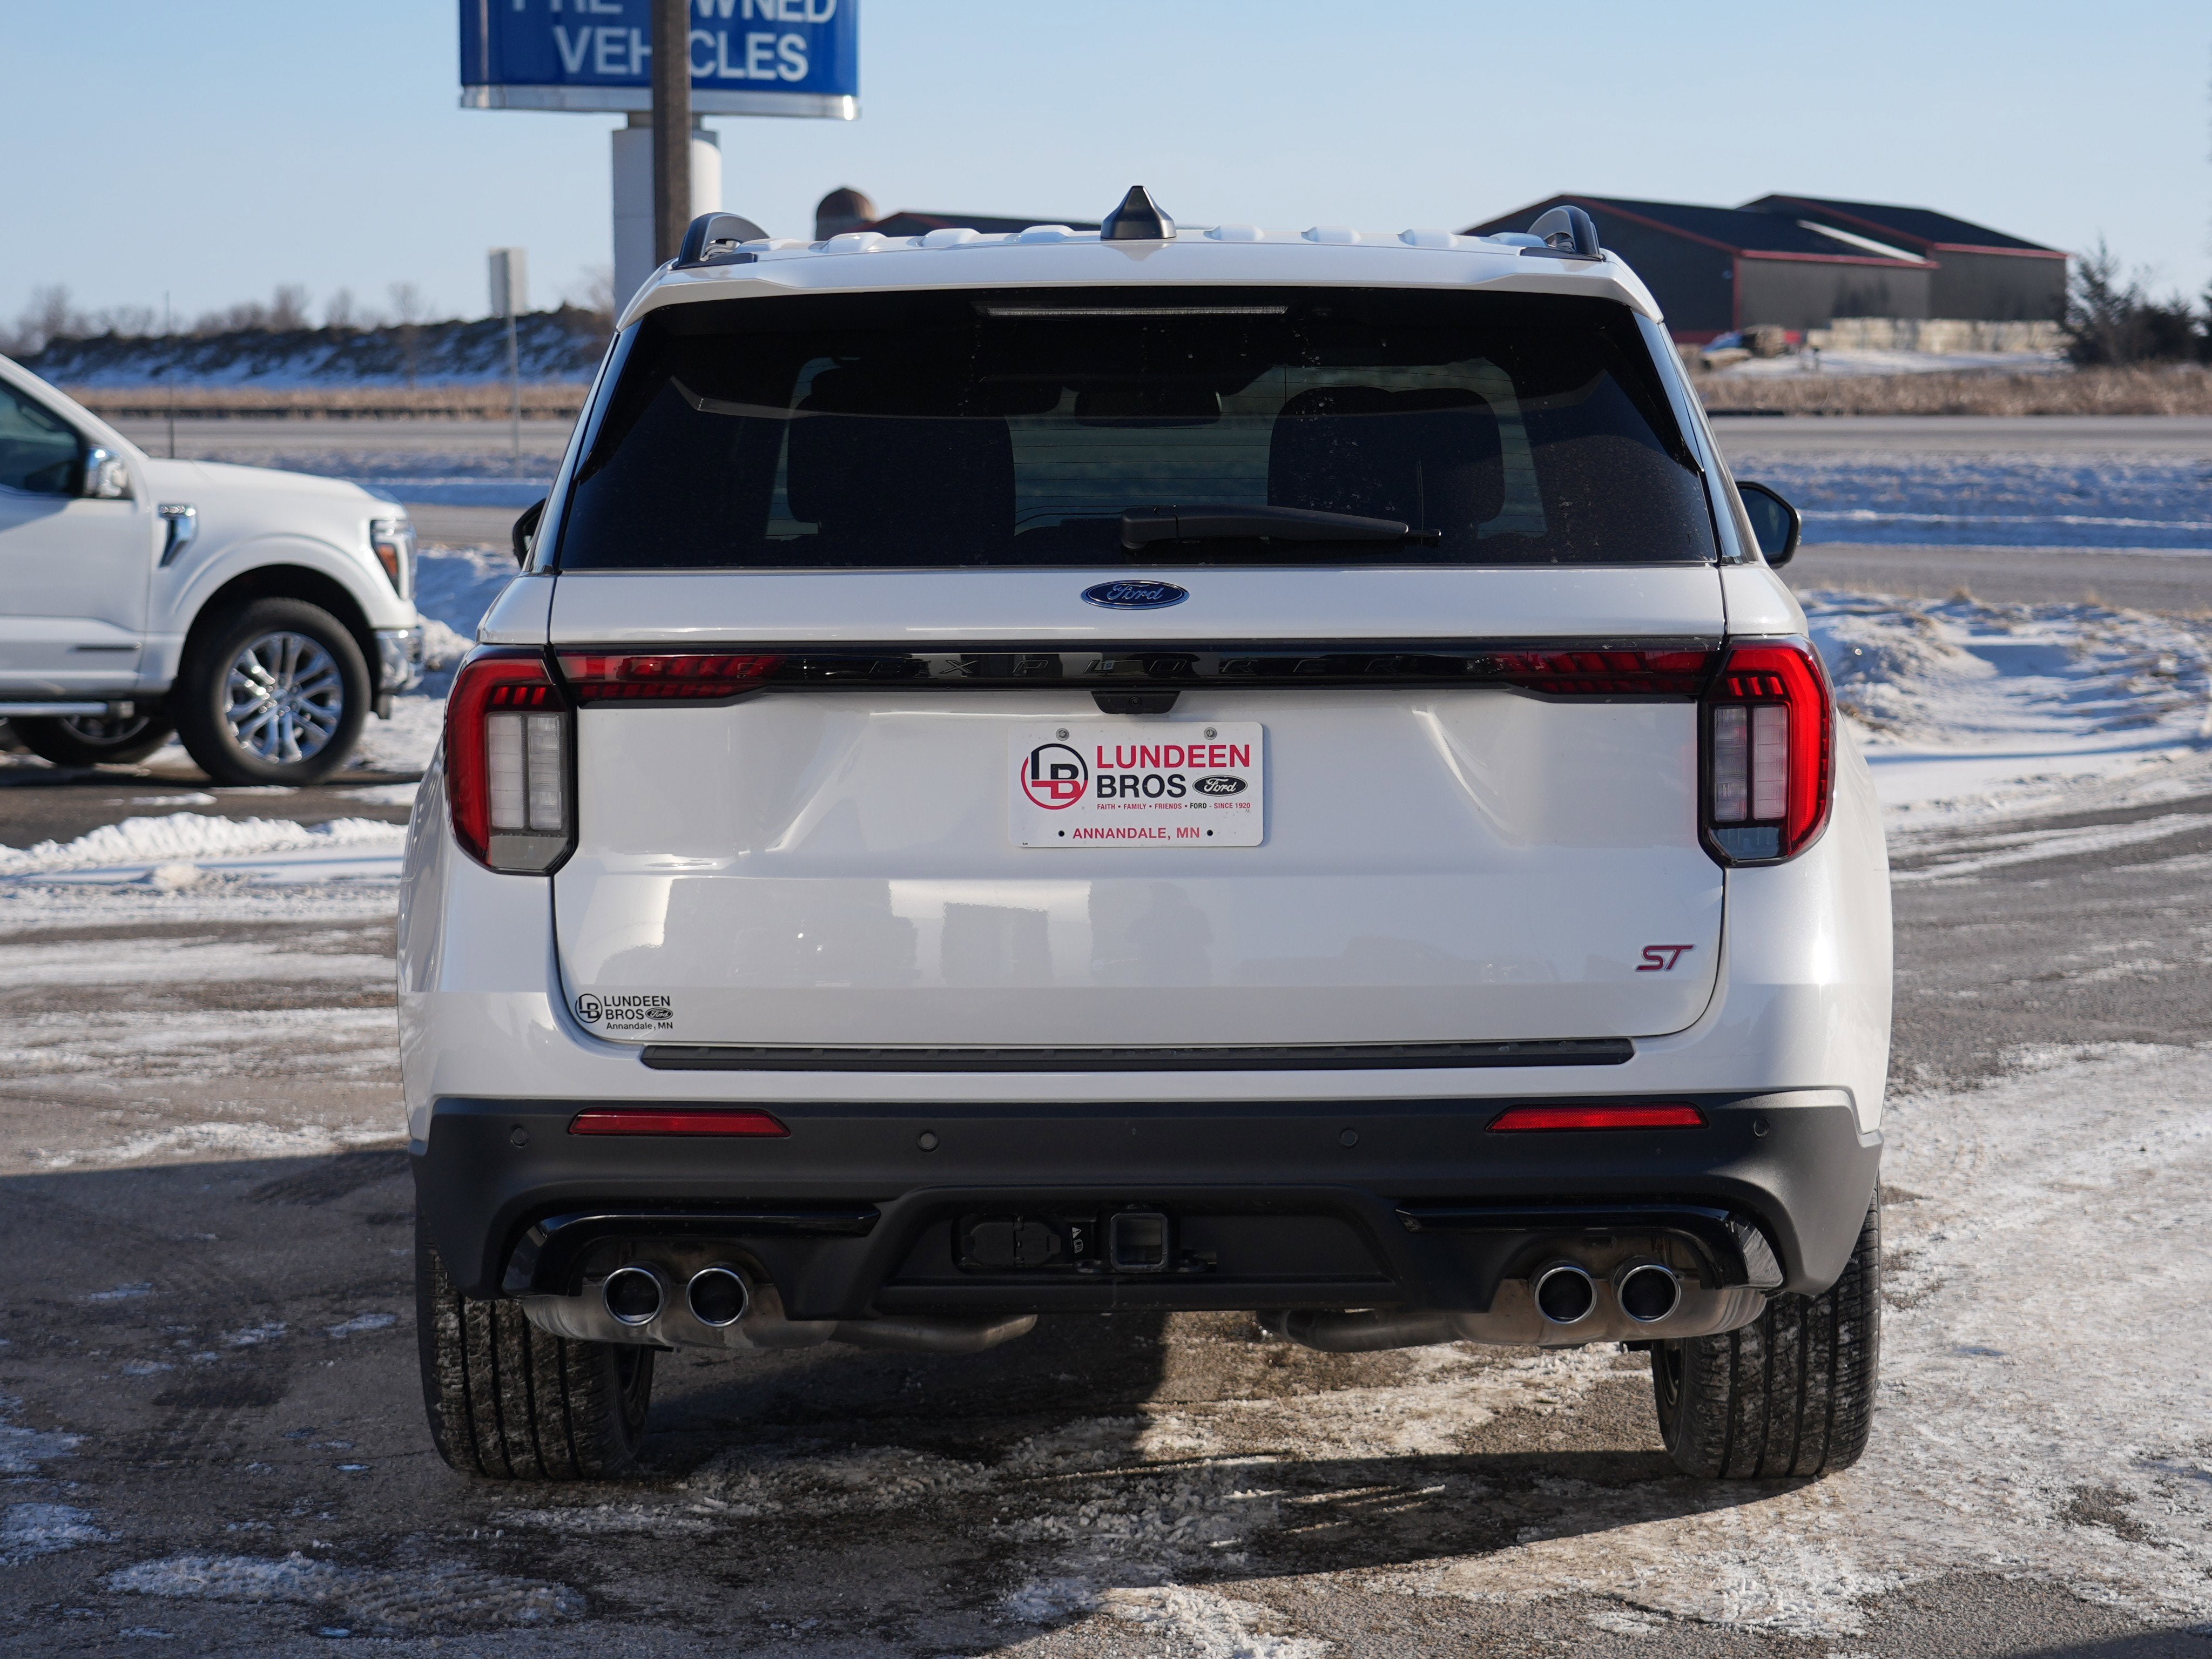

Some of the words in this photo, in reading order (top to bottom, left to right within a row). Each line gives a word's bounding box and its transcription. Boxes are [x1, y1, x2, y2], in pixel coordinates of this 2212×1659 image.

[552, 26, 809, 82] VEHCLES
[1107, 584, 1164, 601] Ford
[1097, 745, 1250, 768] LUNDEEN
[1097, 774, 1186, 798] BROS
[1203, 778, 1237, 792] Ford
[1073, 827, 1171, 840] ANNANDALE,
[1176, 827, 1200, 838] MN
[1634, 944, 1695, 972] ST
[604, 996, 670, 1007] LUNDEEN
[605, 1009, 644, 1020] BROS
[606, 1022, 656, 1030] Annandale,
